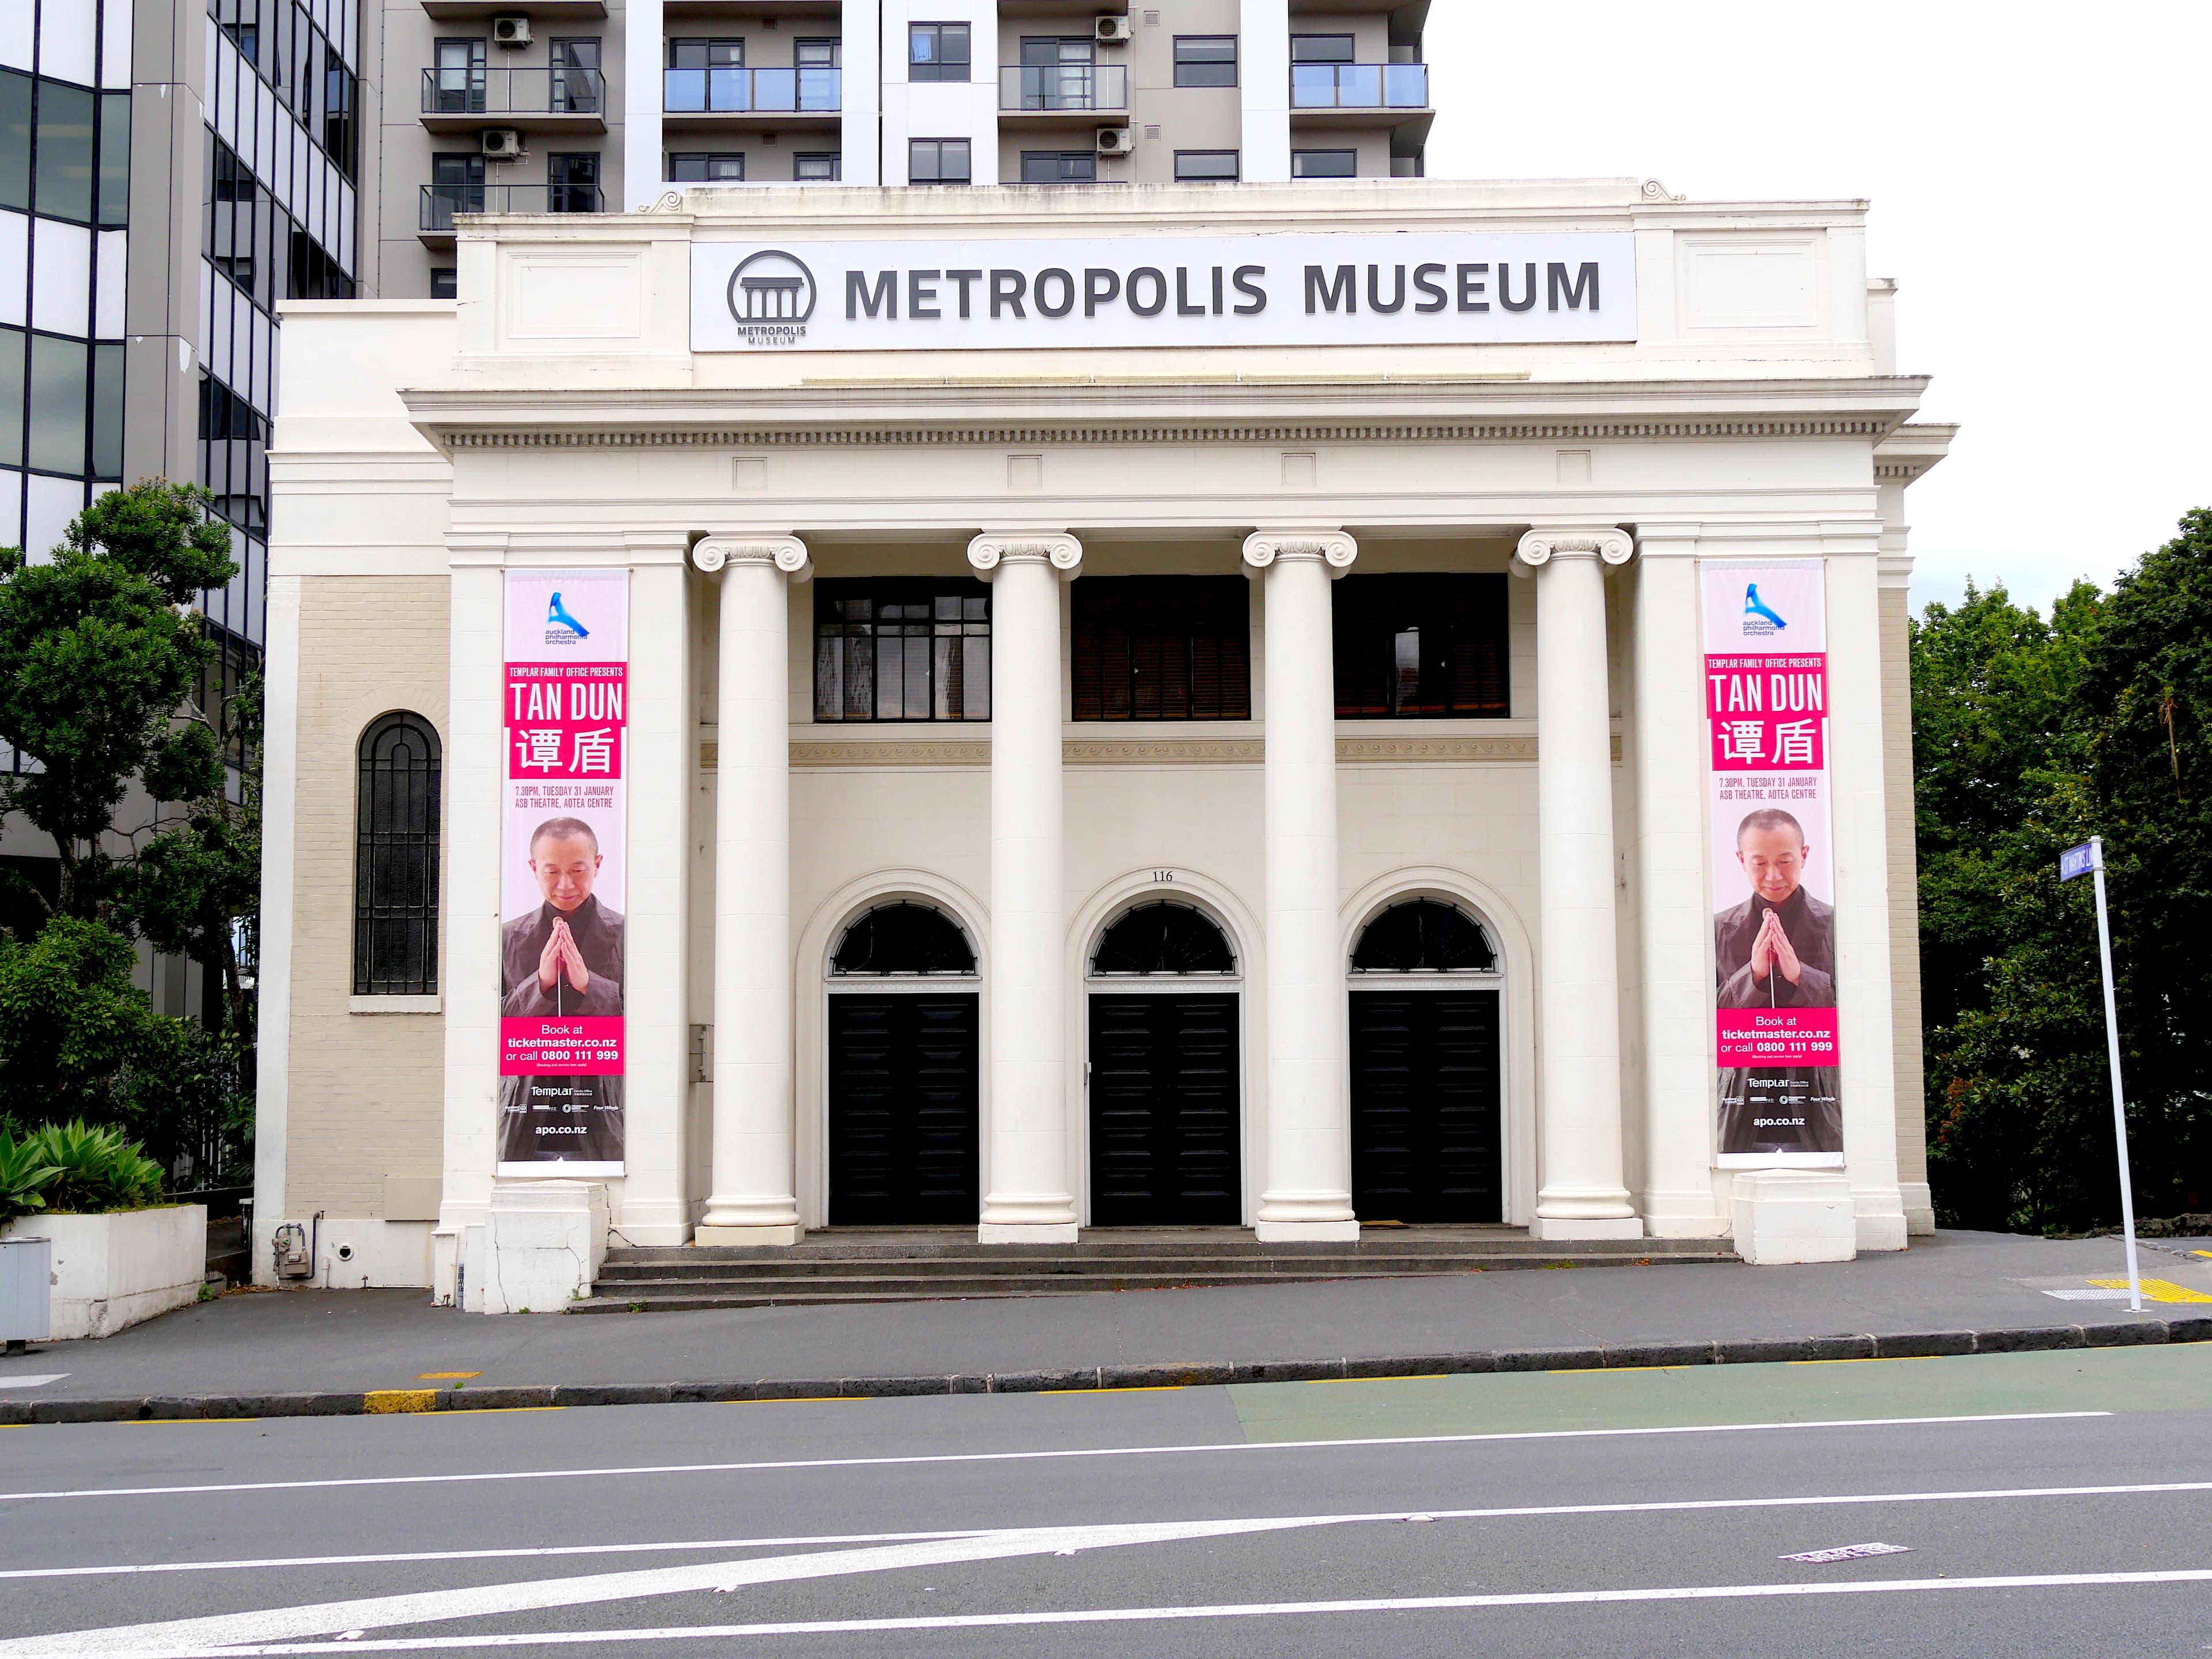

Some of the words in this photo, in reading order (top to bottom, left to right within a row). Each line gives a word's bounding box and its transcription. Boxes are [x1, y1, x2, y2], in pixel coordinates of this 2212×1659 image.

[846, 264, 1268, 319] METROPOLIS
[1304, 261, 1600, 315] MUSEUM
[737, 326, 806, 336] METROPOLIS
[748, 336, 796, 344] MUSEUM
[1708, 658, 1738, 669] TEMPLAR
[1739, 658, 1763, 668] FAMILY
[1765, 658, 1787, 668] OFFICE
[1789, 658, 1821, 668] PRESENTS
[509, 667, 539, 677] TEMPLAR
[540, 667, 564, 677] FAMILY
[566, 667, 588, 677] OFFICE
[590, 666, 623, 677] PRESENTS
[1709, 675, 1762, 712] TAN
[1771, 674, 1823, 711] DUN
[509, 683, 562, 721] TAN
[571, 683, 622, 721] DUN
[1718, 718, 1816, 765] 谭盾
[516, 727, 615, 773] 谭盾
[1719, 778, 1745, 789] 7.30PM,
[1747, 777, 1775, 787] TUESDAY
[1778, 777, 1786, 787] 31
[1787, 777, 1817, 787] JANUARY
[515, 786, 540, 797] 7.30PM,
[543, 786, 571, 796] TUESDAY
[574, 786, 582, 796] 31
[584, 786, 614, 796] JANUARY
[1719, 790, 1733, 800] ASB
[1734, 790, 1766, 801] THEATRE,
[1768, 790, 1789, 800] AOTEA
[1791, 789, 1816, 799] CENTRE
[515, 798, 528, 808] ASB
[530, 798, 562, 809] THEATRE,
[564, 798, 585, 808] AOTEA
[588, 798, 613, 808] CENTRE
[1153, 870, 1173, 881] 116
[1756, 1016, 1783, 1026] Book
[1786, 1017, 1797, 1025] at
[541, 1025, 570, 1035] Book
[573, 1025, 583, 1034] at
[1722, 1029, 1830, 1040] ticketmaster.co.nz
[507, 1037, 617, 1048] ticketmaster.co.nz
[1721, 1044, 1732, 1052] or
[1735, 1043, 1753, 1052] call
[1757, 1042, 1785, 1052] 0800
[1789, 1042, 1806, 1051] 111
[1811, 1041, 1832, 1051] 999
[506, 1052, 517, 1060] or
[520, 1051, 538, 1060] call
[541, 1051, 570, 1060] 0800
[574, 1051, 592, 1060] 111
[596, 1050, 618, 1060] 999
[1753, 1118, 1805, 1127] apo.co.nz
[535, 1126, 588, 1136] apo.co.nz
